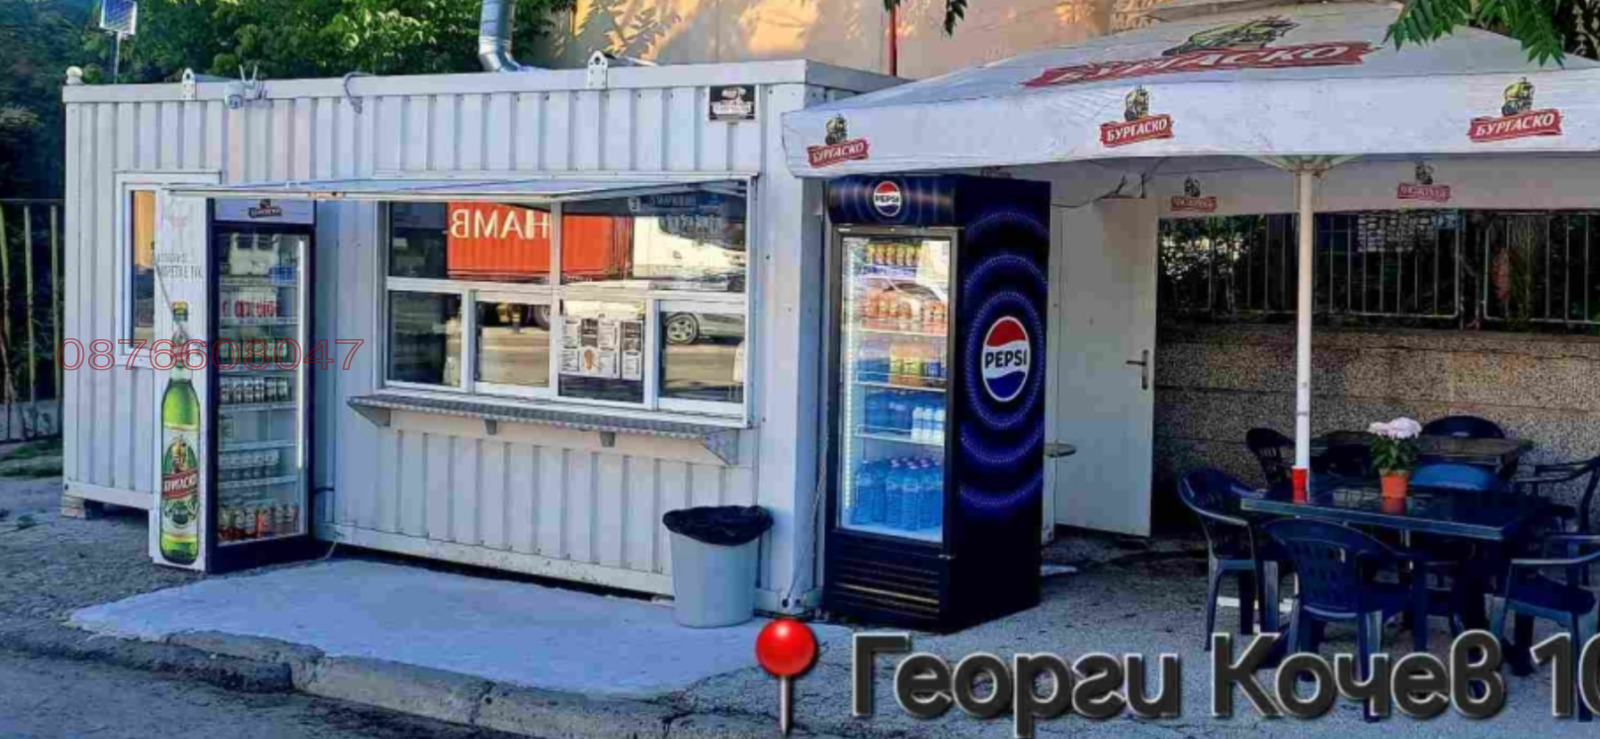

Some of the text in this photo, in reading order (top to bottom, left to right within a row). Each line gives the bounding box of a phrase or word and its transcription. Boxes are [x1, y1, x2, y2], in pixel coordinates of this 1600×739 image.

[1107, 118, 1168, 142] БУРГАСКО
[1474, 113, 1555, 137] БУРГАСКО
[875, 194, 900, 204] PEPSI
[985, 349, 1028, 369] PEPSI
